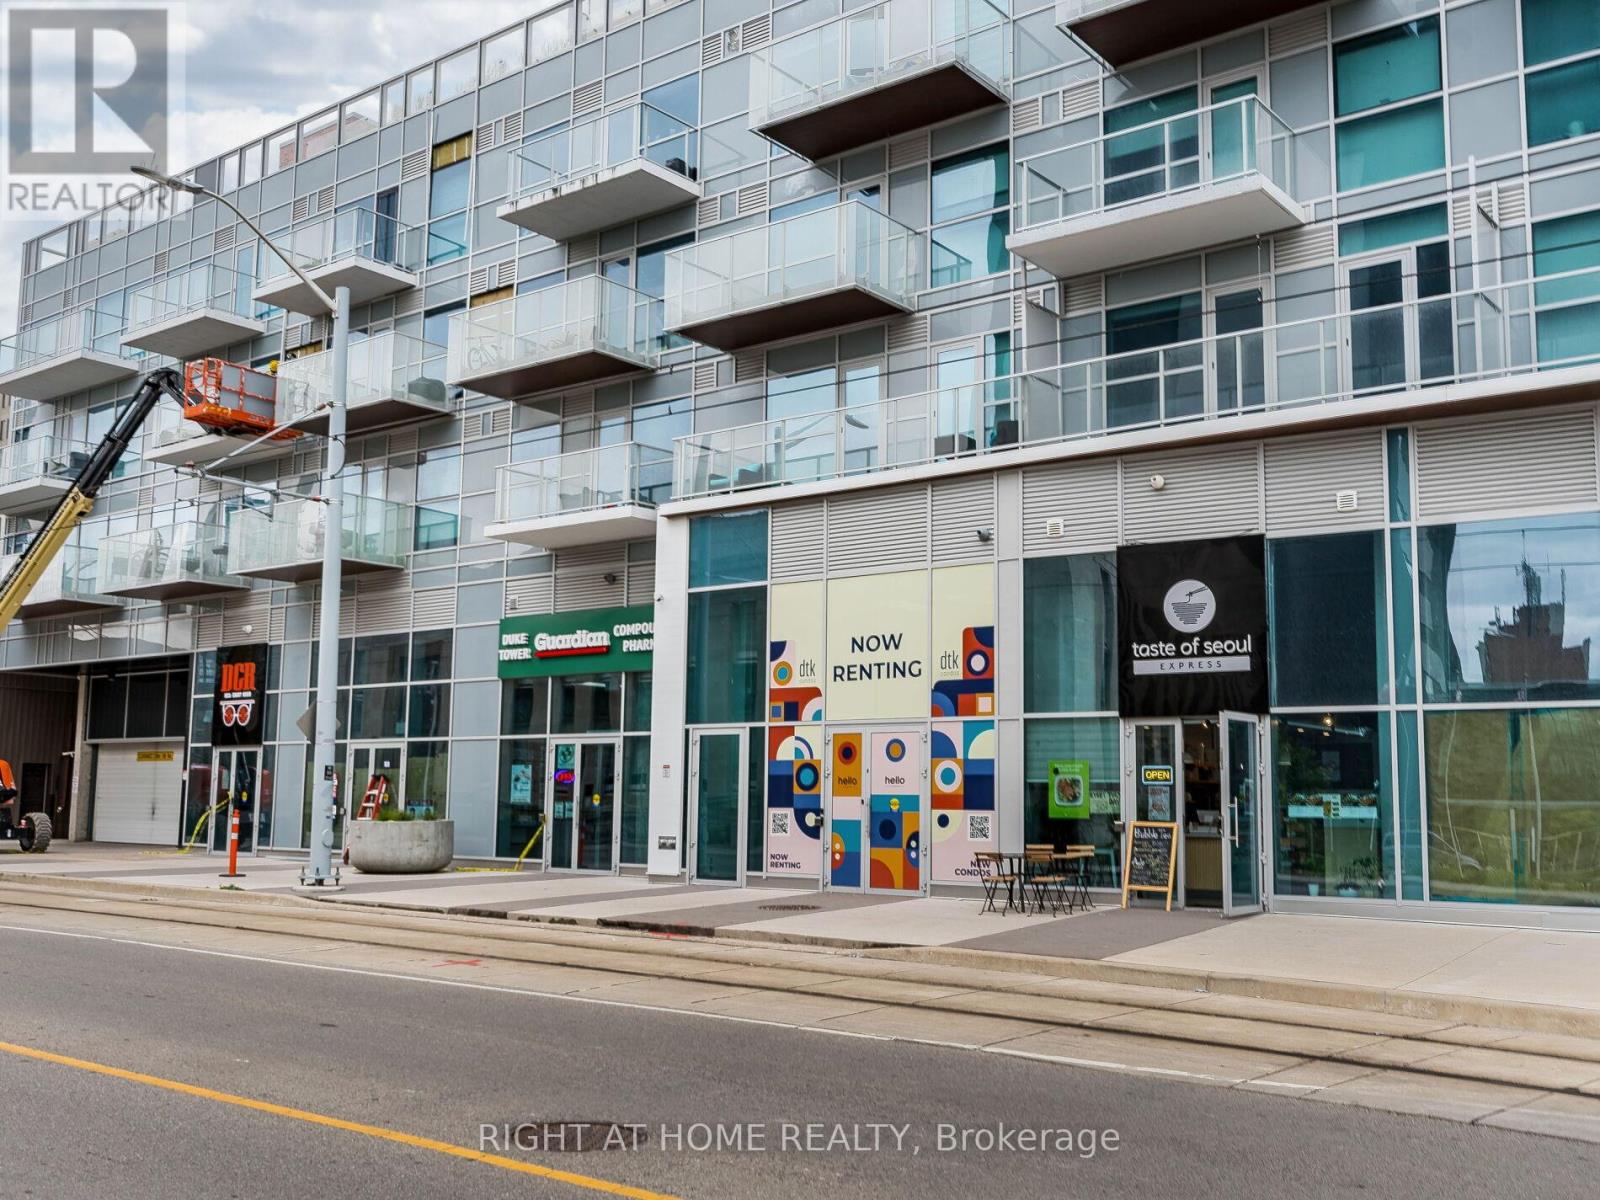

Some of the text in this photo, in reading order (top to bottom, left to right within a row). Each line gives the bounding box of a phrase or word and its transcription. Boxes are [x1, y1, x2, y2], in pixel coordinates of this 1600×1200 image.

[502, 633, 529, 646] DUKE
[534, 629, 611, 651] Guardian
[850, 633, 903, 653] NOW
[1132, 634, 1252, 657] taste of seoul
[498, 647, 531, 660] TOWER
[941, 650, 959, 670] dtk
[800, 659, 816, 677] dtk
[833, 660, 922, 682] RENTING
[1160, 660, 1222, 671] EXPRESS
[838, 775, 858, 785] hello
[884, 775, 906, 785] hello
[1145, 770, 1170, 780] OPEN
[770, 853, 788, 861] NOW
[770, 861, 801, 869] RENTING
[954, 868, 991, 877] CONDOS
